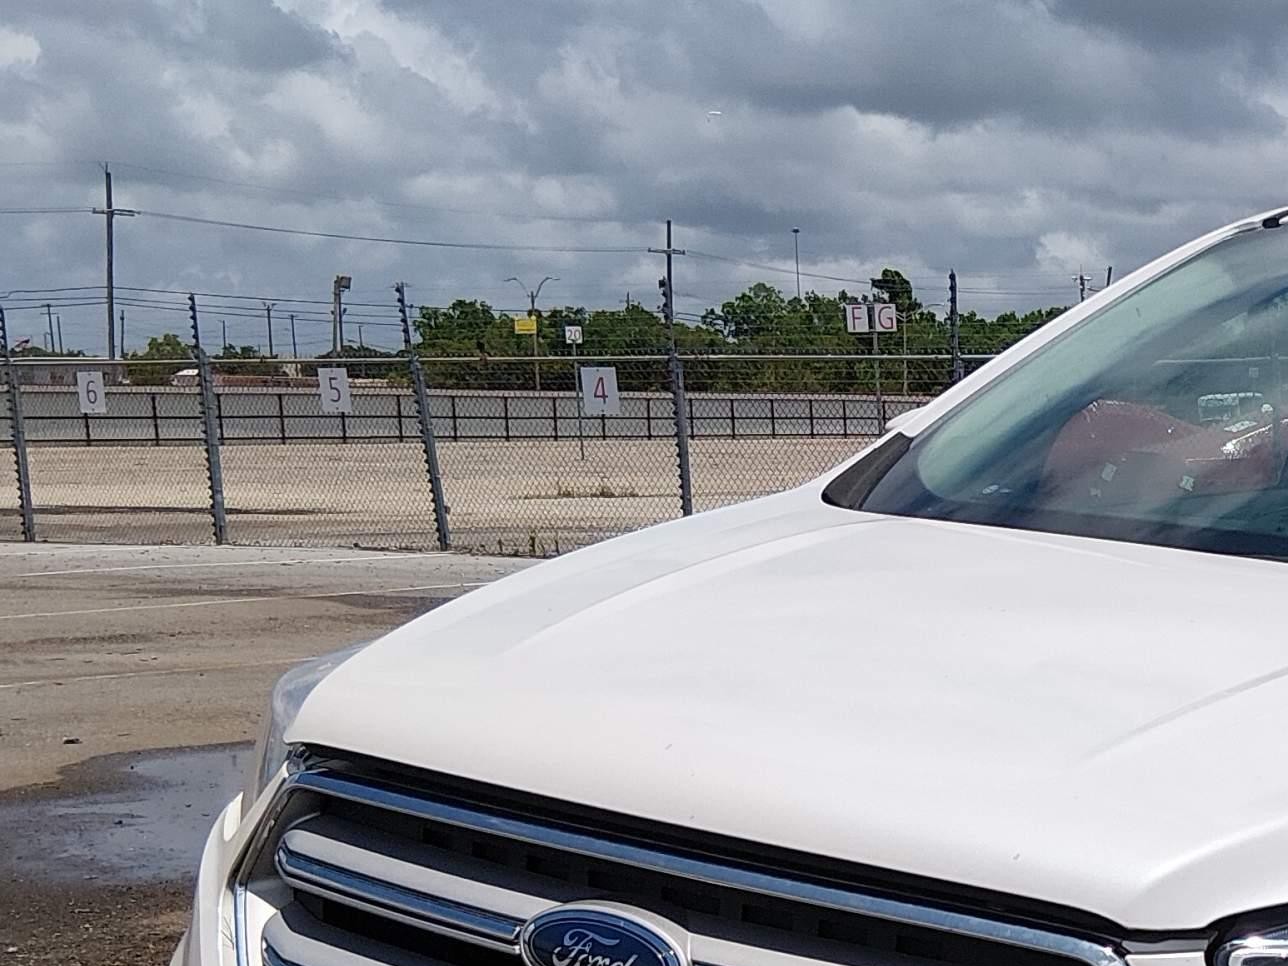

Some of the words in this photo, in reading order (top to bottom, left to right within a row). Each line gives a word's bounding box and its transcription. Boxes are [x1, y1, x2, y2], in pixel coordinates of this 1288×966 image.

[852, 307, 864, 330] F
[878, 306, 895, 330] G
[568, 329, 581, 341] 20
[85, 380, 98, 405] 6
[329, 376, 343, 403] 5
[593, 377, 609, 403] 4
